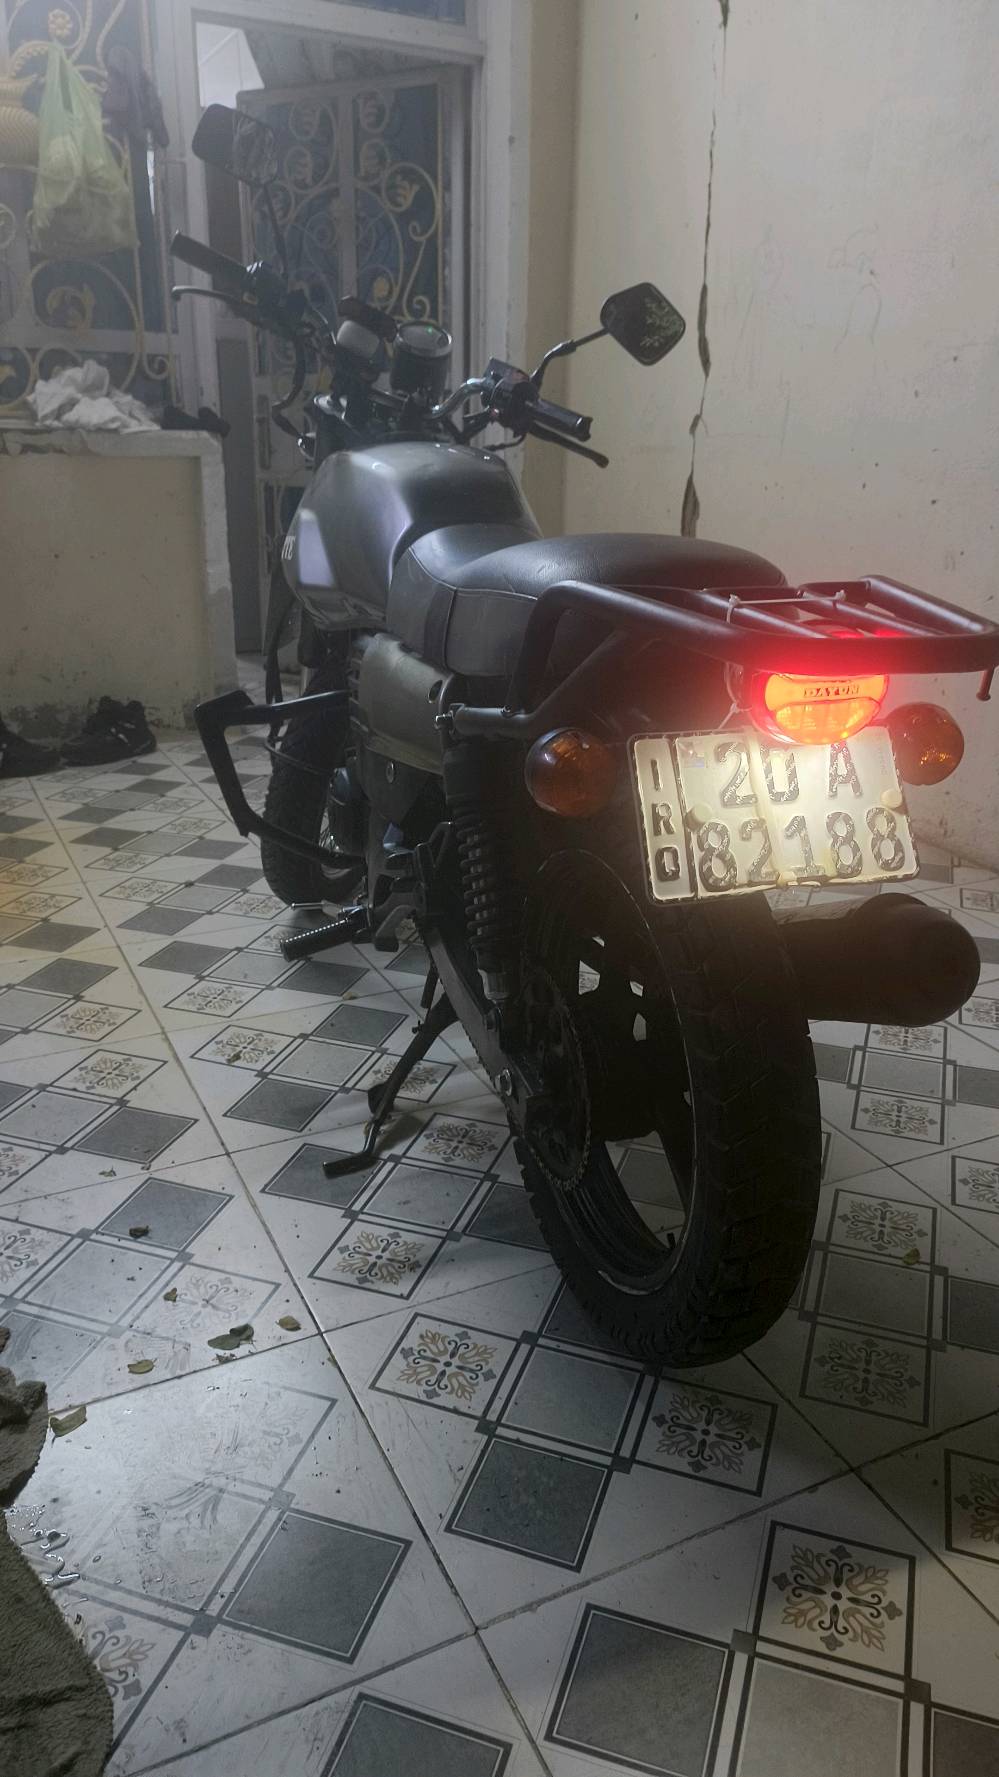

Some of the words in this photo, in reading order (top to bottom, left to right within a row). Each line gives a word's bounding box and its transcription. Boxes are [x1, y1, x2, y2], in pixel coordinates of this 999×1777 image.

[828, 740, 864, 798] A
[651, 758, 681, 882] IRQ
[698, 806, 906, 893] 82188
